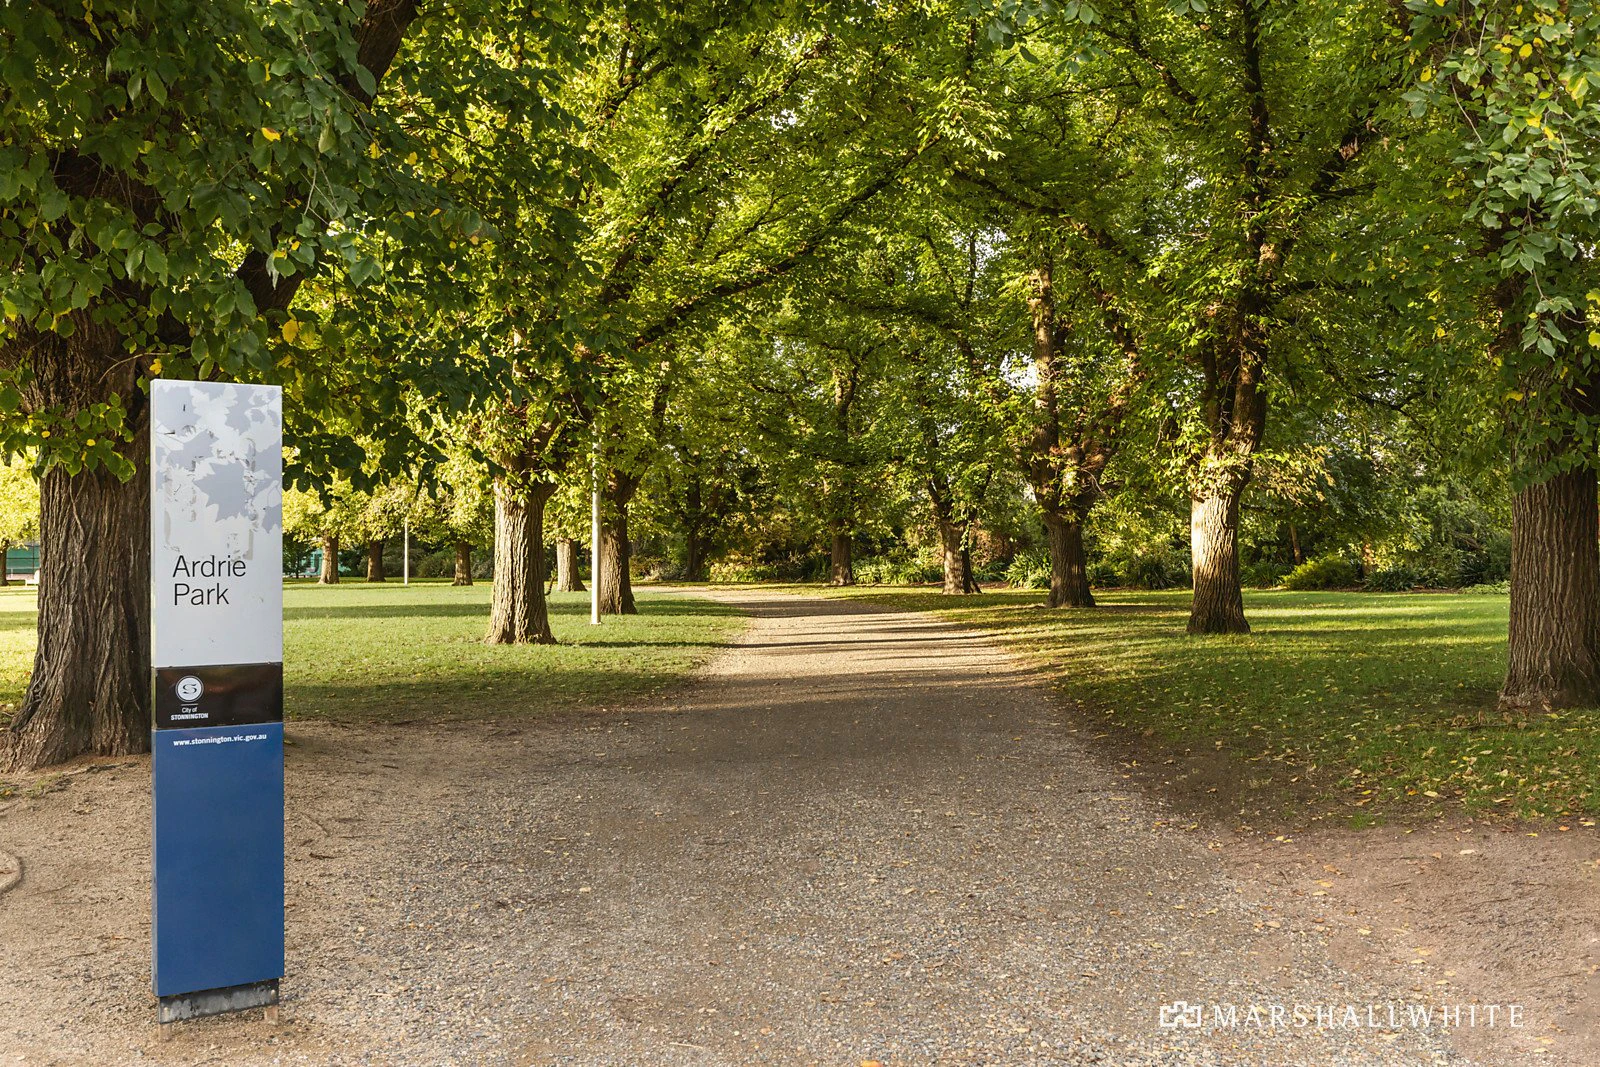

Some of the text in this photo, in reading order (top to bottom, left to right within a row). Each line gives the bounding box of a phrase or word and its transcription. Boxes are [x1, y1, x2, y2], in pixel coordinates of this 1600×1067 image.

[172, 555, 246, 577] Ardrie
[174, 582, 230, 606] Park
[173, 734, 267, 746] www.stonnington.vic.gov.au
